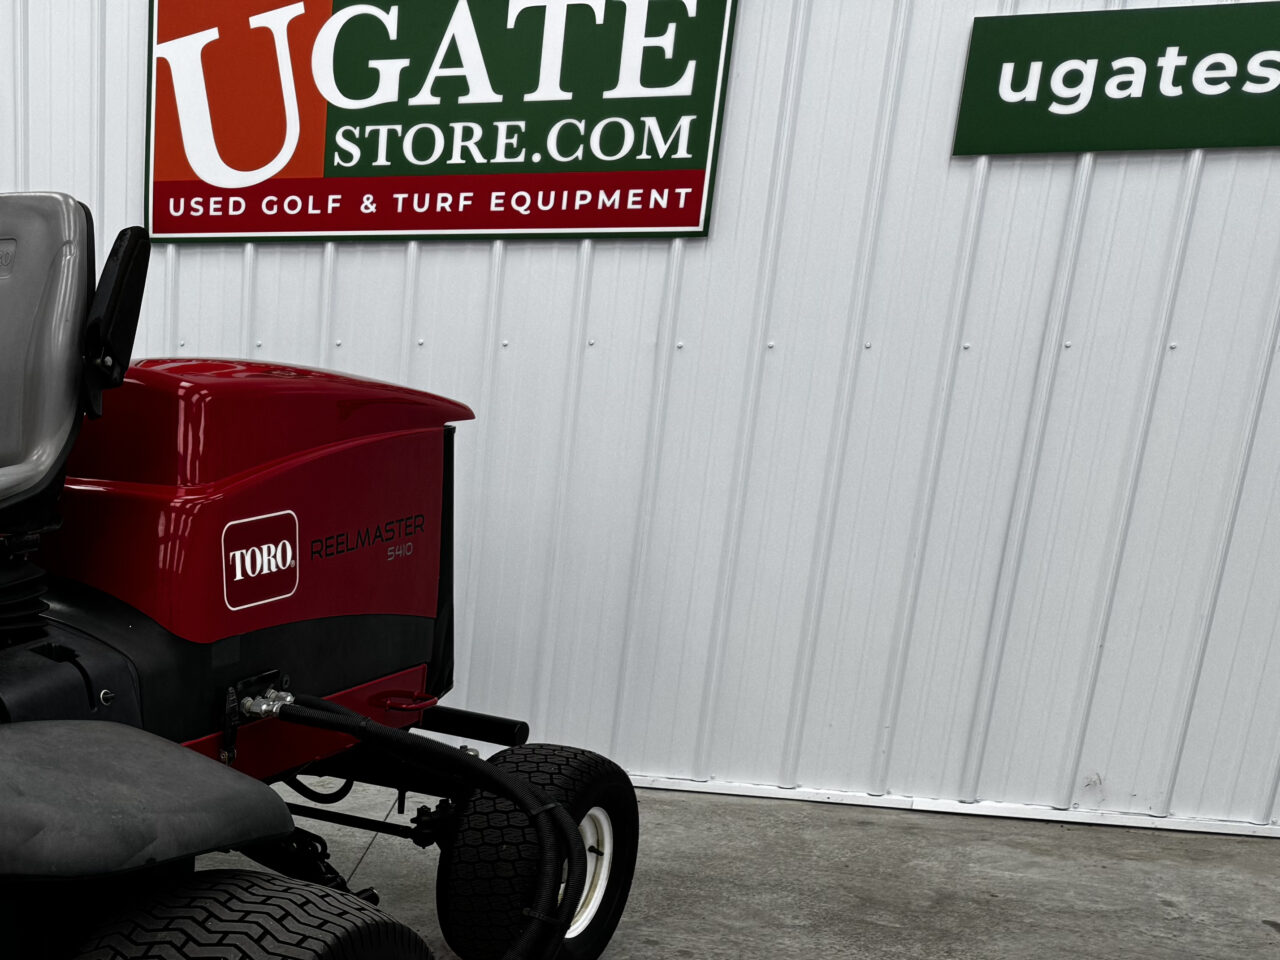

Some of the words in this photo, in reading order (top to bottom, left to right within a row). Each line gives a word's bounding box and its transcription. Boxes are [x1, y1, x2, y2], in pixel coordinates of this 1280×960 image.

[156, 0, 697, 189] UGATE
[333, 115, 697, 167] STORE.COM
[169, 196, 247, 217] USED
[261, 194, 342, 215] GOLF
[360, 193, 377, 214] &
[393, 192, 474, 213] TURF
[490, 188, 693, 215] EQUIPMENT
[310, 514, 425, 561] REELMASTER
[387, 542, 413, 561] 5410
[229, 539, 293, 581] TORO
